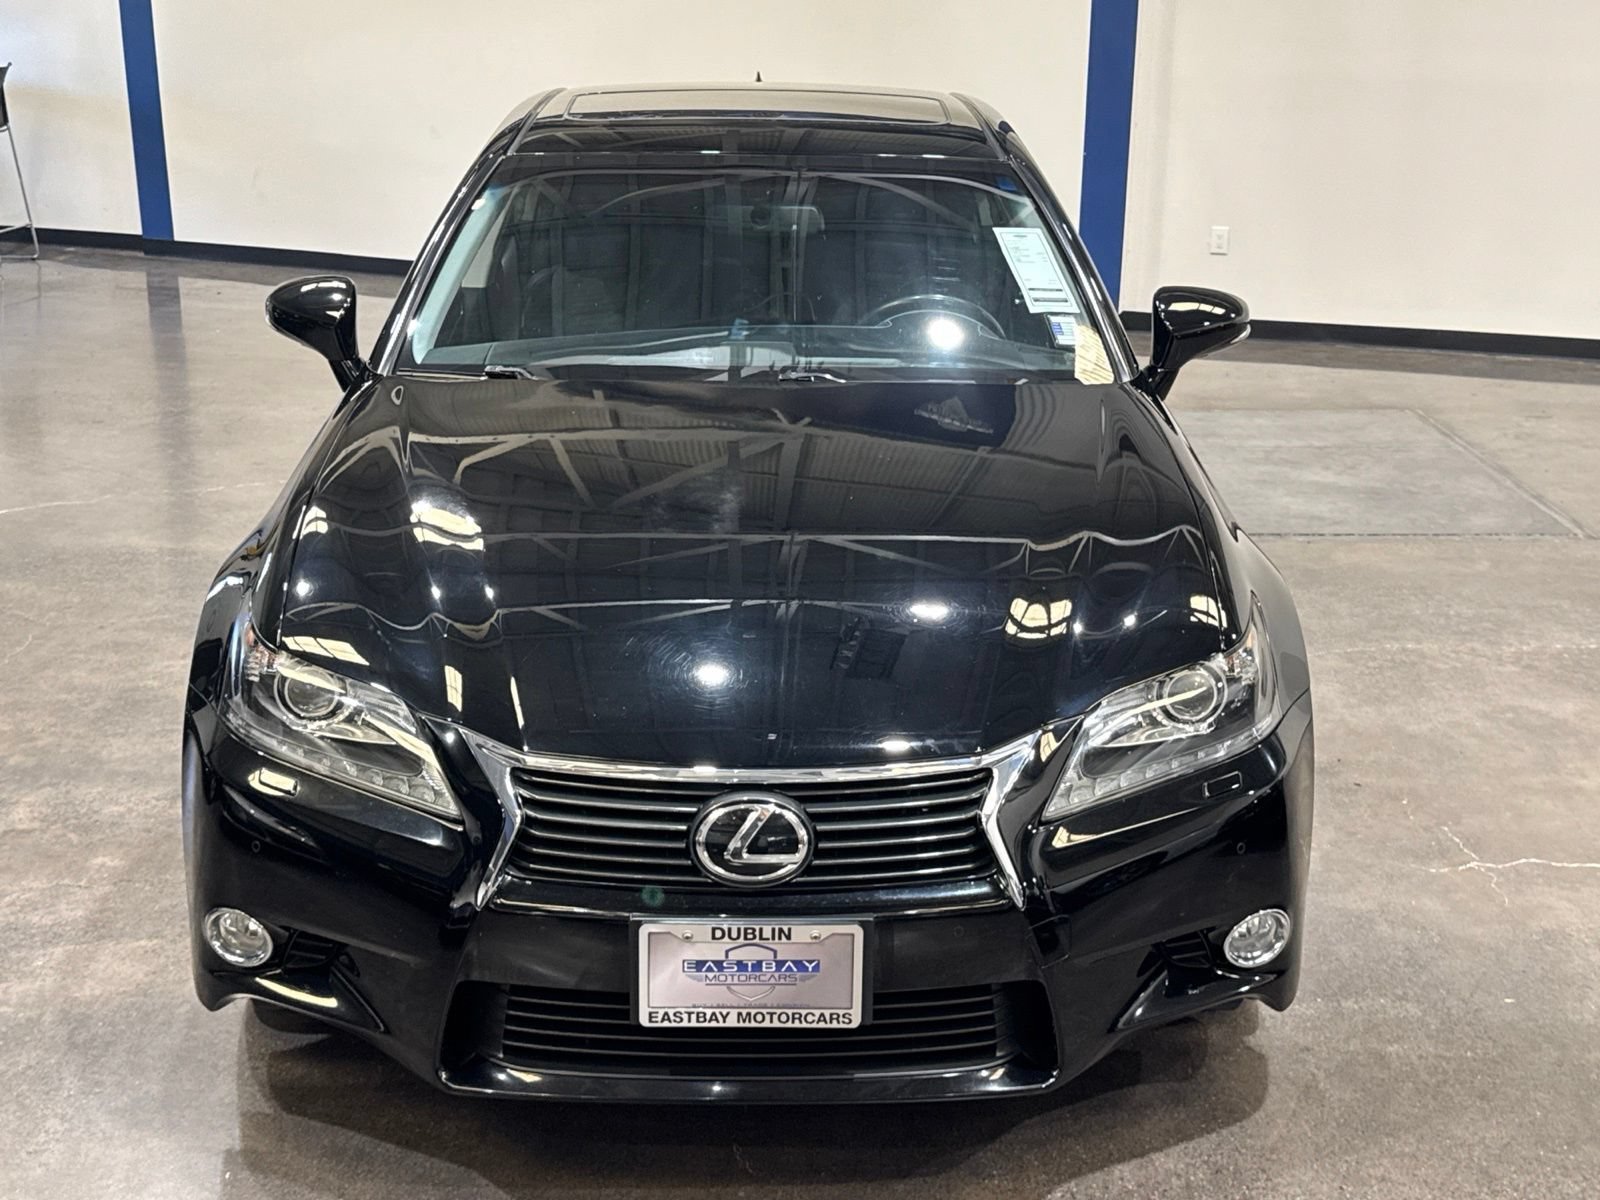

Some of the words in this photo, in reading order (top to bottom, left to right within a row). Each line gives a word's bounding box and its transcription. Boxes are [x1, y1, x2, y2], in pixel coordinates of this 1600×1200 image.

[711, 926, 792, 941] DUBLIN
[683, 960, 820, 972] EASTBAY
[704, 973, 799, 983] MOTORCARS
[648, 1011, 731, 1024] EASTBAY
[737, 1011, 853, 1025] MOTORCARS
